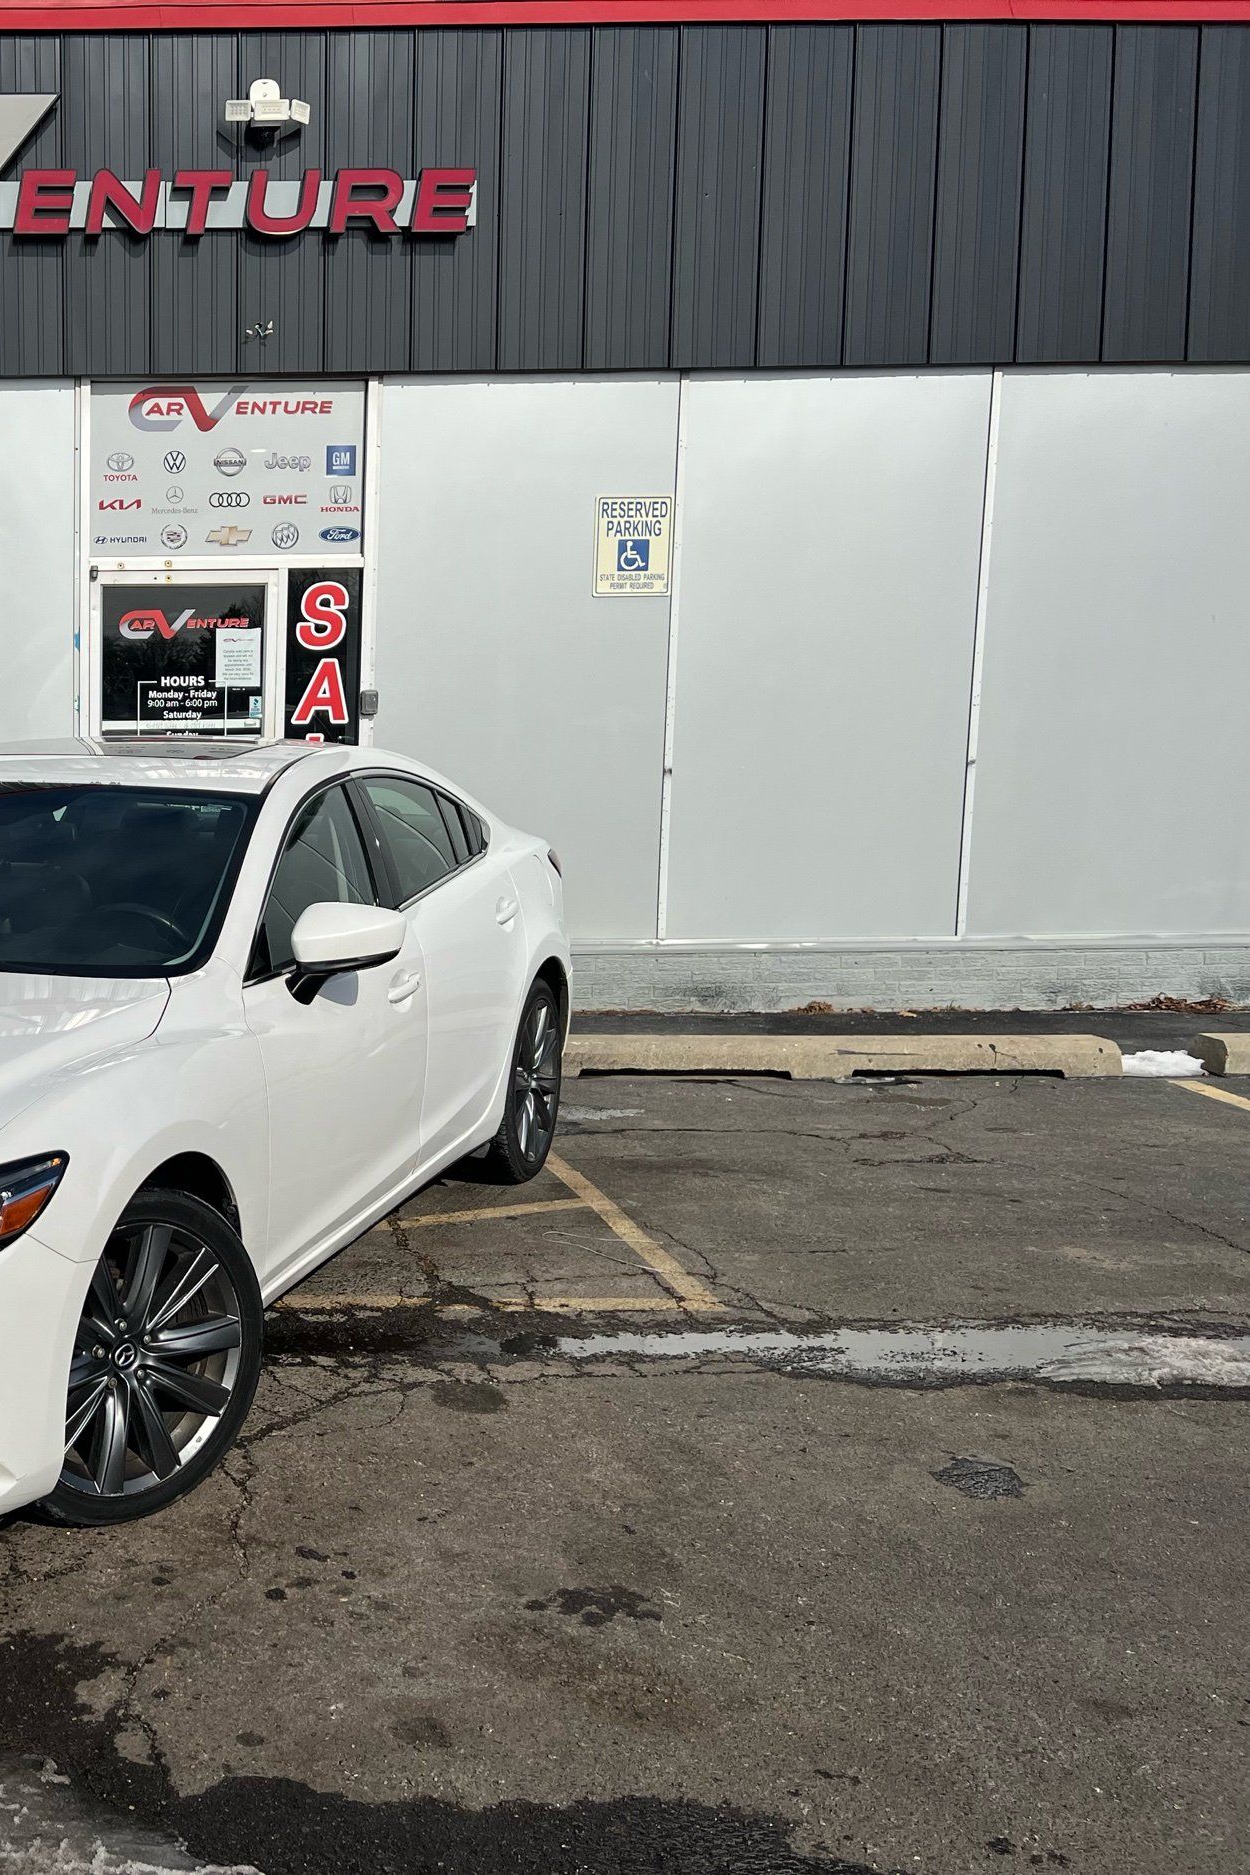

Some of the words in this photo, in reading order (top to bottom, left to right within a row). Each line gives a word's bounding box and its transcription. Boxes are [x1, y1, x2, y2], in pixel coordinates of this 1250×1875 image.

[264, 452, 311, 472] Jeep
[332, 451, 350, 466] GM
[103, 474, 138, 482] TOYOTA
[98, 498, 141, 511] KIA
[262, 494, 308, 505] GMC
[601, 501, 668, 519] RESERVED
[606, 519, 662, 537] PARKING
[326, 528, 353, 541] Ford
[599, 573, 615, 581] STATE
[617, 573, 641, 581] DISABLED
[643, 573, 665, 581] PARKING
[609, 582, 627, 590] PERMIT
[629, 582, 654, 590] REQUIRED
[291, 580, 350, 741] SA
[160, 675, 205, 687] HOURS
[148, 690, 184, 699] Monday
[189, 689, 217, 699] Friday
[147, 700, 165, 708] 9:00
[185, 699, 203, 707] 6:00
[204, 700, 218, 708] pm
[163, 710, 202, 720] Saturday
